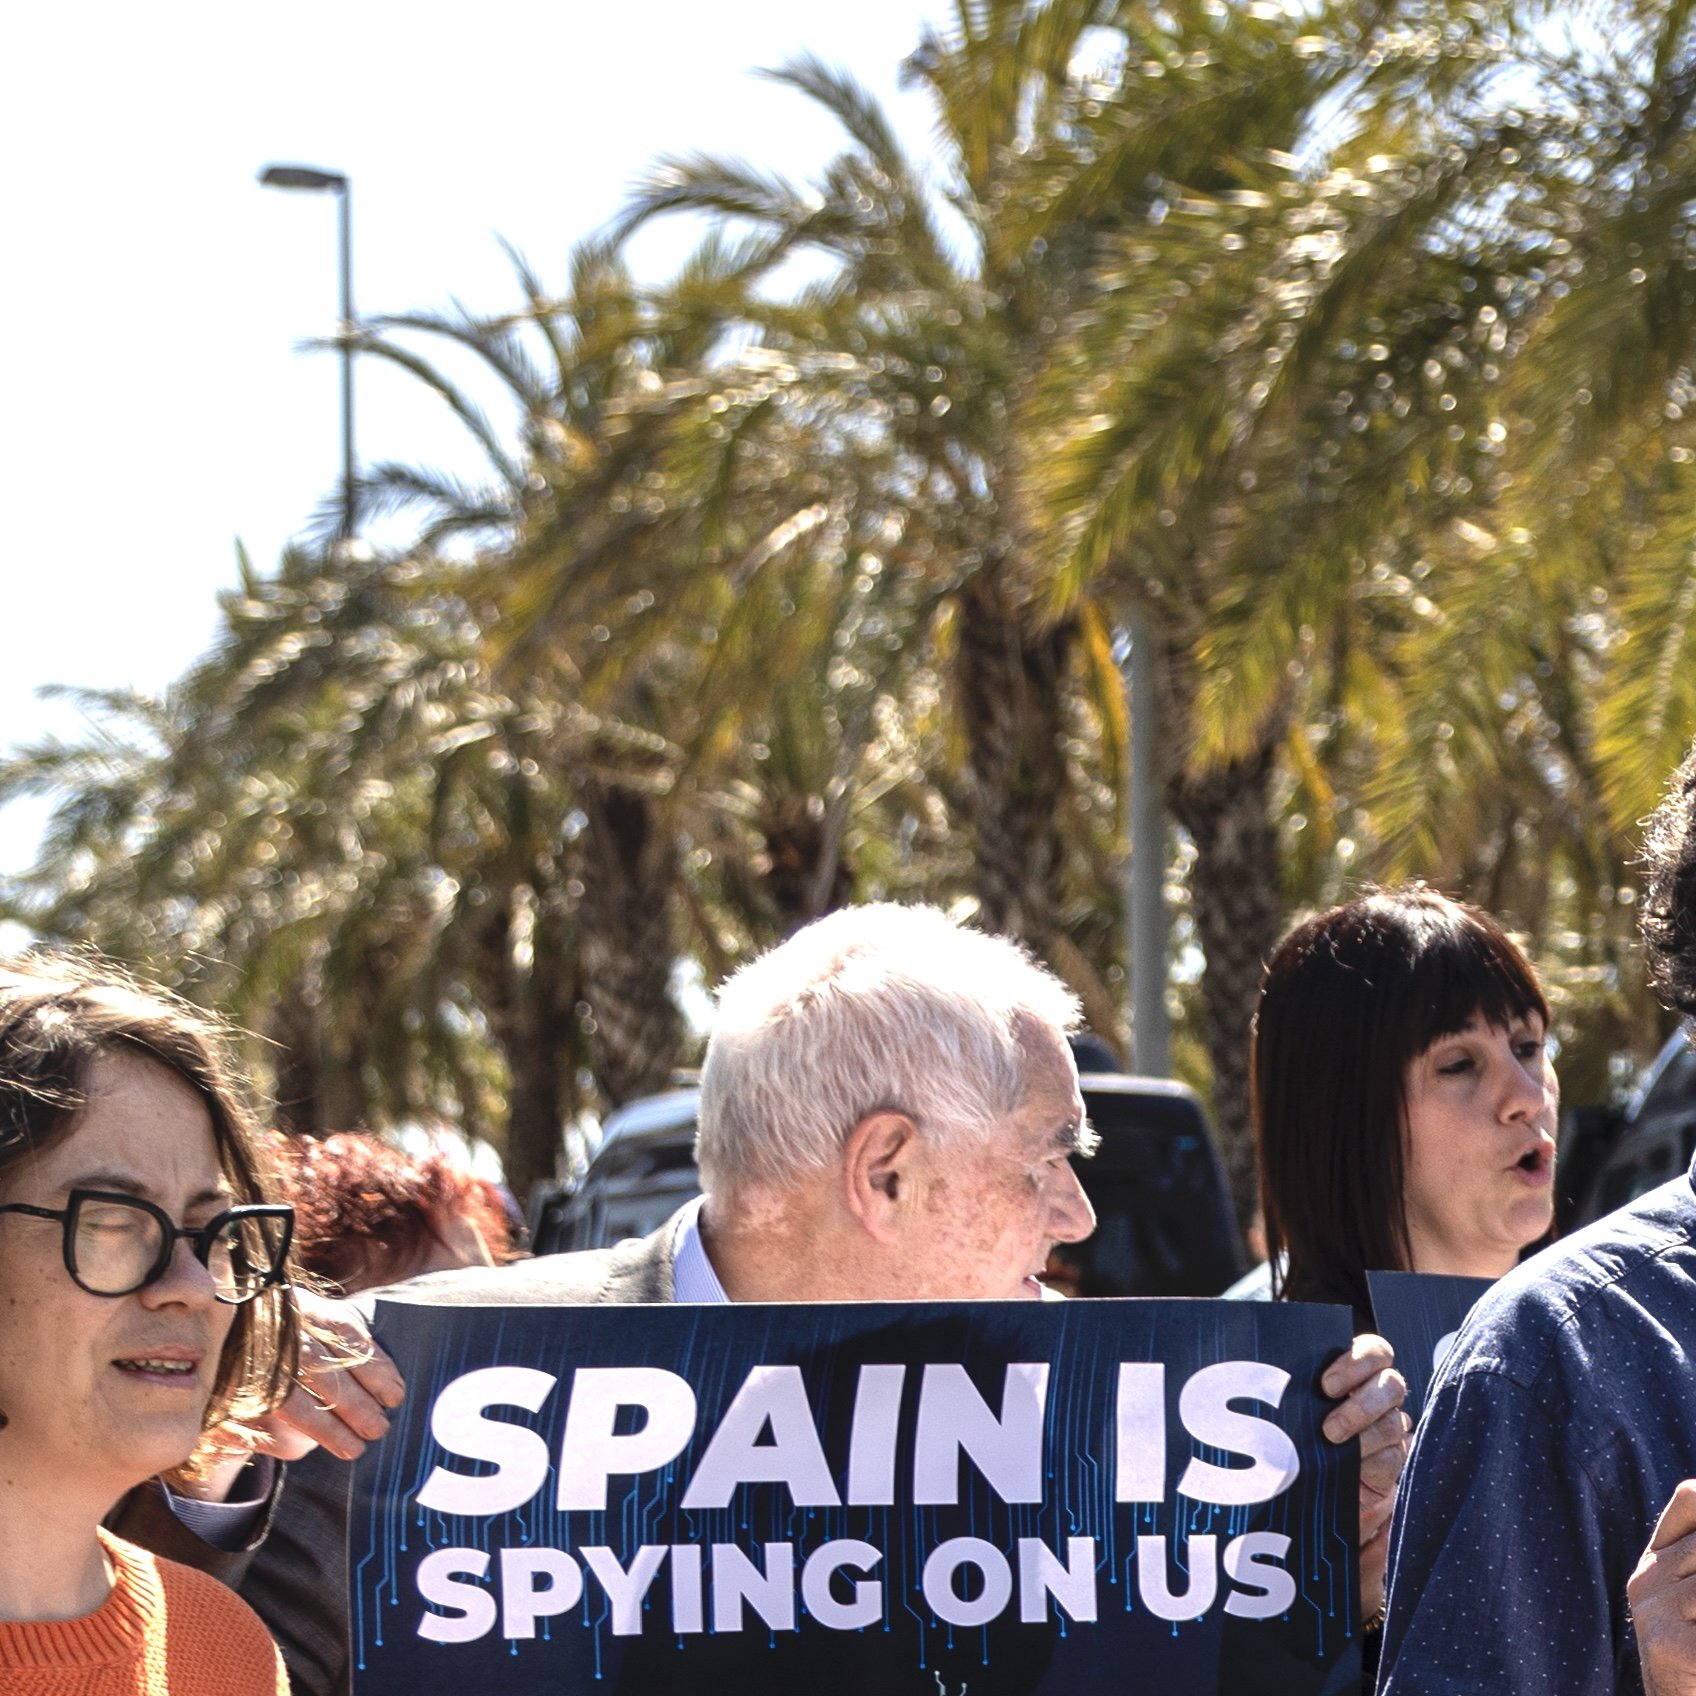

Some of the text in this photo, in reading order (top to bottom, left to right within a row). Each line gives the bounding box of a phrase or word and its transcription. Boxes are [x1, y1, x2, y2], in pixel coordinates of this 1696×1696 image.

[415, 1360, 1301, 1517] SPAIN IS
[415, 1531, 1297, 1645] SPYING ON US
